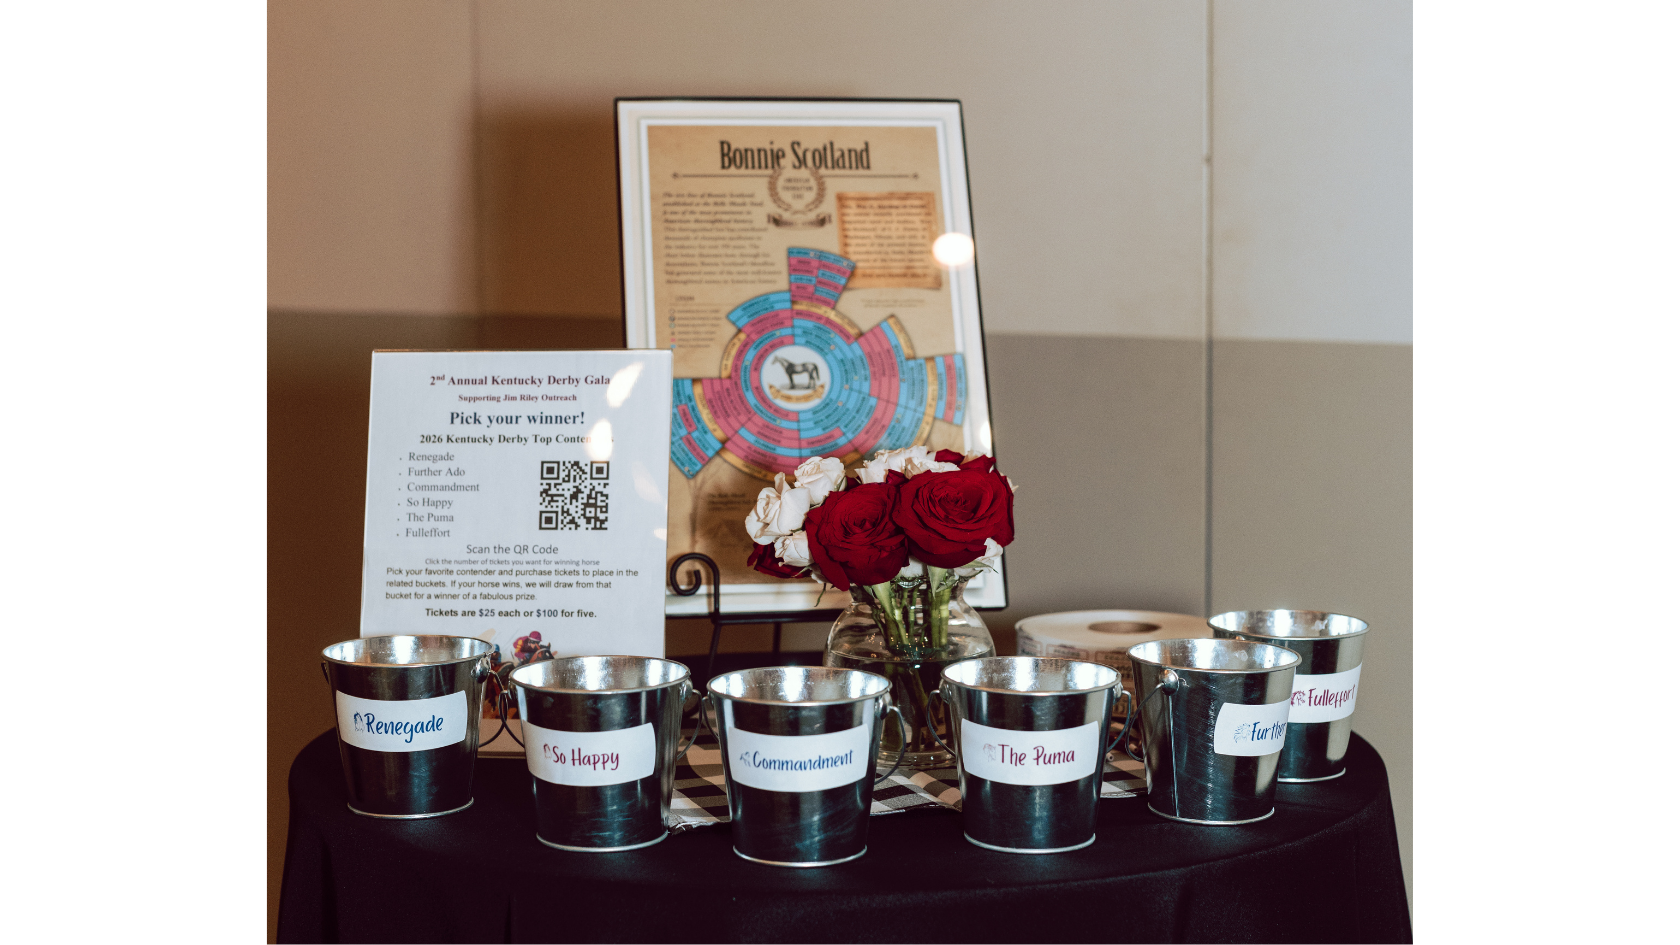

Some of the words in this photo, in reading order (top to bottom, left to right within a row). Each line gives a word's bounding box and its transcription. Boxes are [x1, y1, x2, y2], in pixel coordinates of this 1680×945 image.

[719, 140, 786, 170] Bonnie
[791, 140, 870, 170] Scotland
[430, 374, 446, 386] 2nd
[448, 376, 488, 386] Annual
[491, 375, 544, 388] Kentucky
[547, 375, 581, 388] Derby
[584, 374, 611, 386] Gala
[458, 394, 501, 403] Supporting
[503, 394, 518, 402] Jim
[519, 394, 539, 403] Riley
[541, 394, 577, 402] Outreach
[450, 412, 483, 425] Pick
[487, 415, 523, 428] your
[527, 411, 585, 425] winner!
[420, 434, 444, 444] 2026
[446, 434, 495, 446] Kentucky
[498, 434, 530, 446] Derby
[532, 434, 553, 446] Top
[408, 452, 455, 464] Renegade
[408, 467, 443, 477] Further
[445, 467, 466, 477] Ado
[407, 482, 480, 492] Commandment
[406, 497, 420, 507] So
[422, 497, 454, 510] Happy
[406, 512, 425, 522] The
[427, 512, 455, 522] Puma
[405, 527, 451, 538] Fulleffort
[466, 543, 491, 555] Scan
[493, 543, 511, 555] the
[513, 544, 530, 556] QR
[532, 544, 559, 555] Code
[425, 557, 440, 565] Click
[441, 557, 453, 565] the
[454, 558, 480, 566] number
[480, 557, 488, 566] of
[489, 558, 510, 566] tickets
[554, 559, 581, 567] winning
[386, 567, 403, 576] Pick
[405, 569, 423, 578] your
[425, 567, 454, 576] favorite
[456, 568, 497, 576] contender
[498, 568, 513, 576] and
[515, 568, 553, 578] purchase
[554, 568, 580, 577] tickets
[582, 569, 590, 577] to
[592, 569, 614, 578] place
[616, 569, 624, 577] in
[626, 569, 639, 577] the
[386, 580, 413, 588] related
[415, 580, 449, 588] buckets.
[450, 580, 456, 588] If
[478, 580, 501, 588] horse
[502, 580, 523, 589] wins,
[539, 581, 552, 589] will
[554, 581, 574, 589] draw
[576, 581, 595, 589] from
[596, 581, 612, 589] that
[386, 592, 412, 600] bucket
[414, 592, 424, 600] for
[434, 592, 460, 600] winner
[462, 592, 470, 600] of
[479, 592, 514, 601] fabulous
[516, 593, 538, 602] prize.
[425, 608, 459, 617] Tickets
[478, 608, 496, 618] $25
[498, 609, 521, 618] each
[523, 610, 534, 618] or
[536, 608, 559, 618] $100
[561, 609, 575, 618] for
[577, 609, 597, 618] five.
[1308, 684, 1356, 709] Fulleffort
[364, 713, 444, 744] Renegade
[1251, 720, 1287, 741] Further
[552, 745, 566, 765] So
[571, 747, 620, 771] Happy
[753, 749, 854, 771] Commandment
[998, 743, 1027, 767] The
[1032, 745, 1075, 766] Puma
